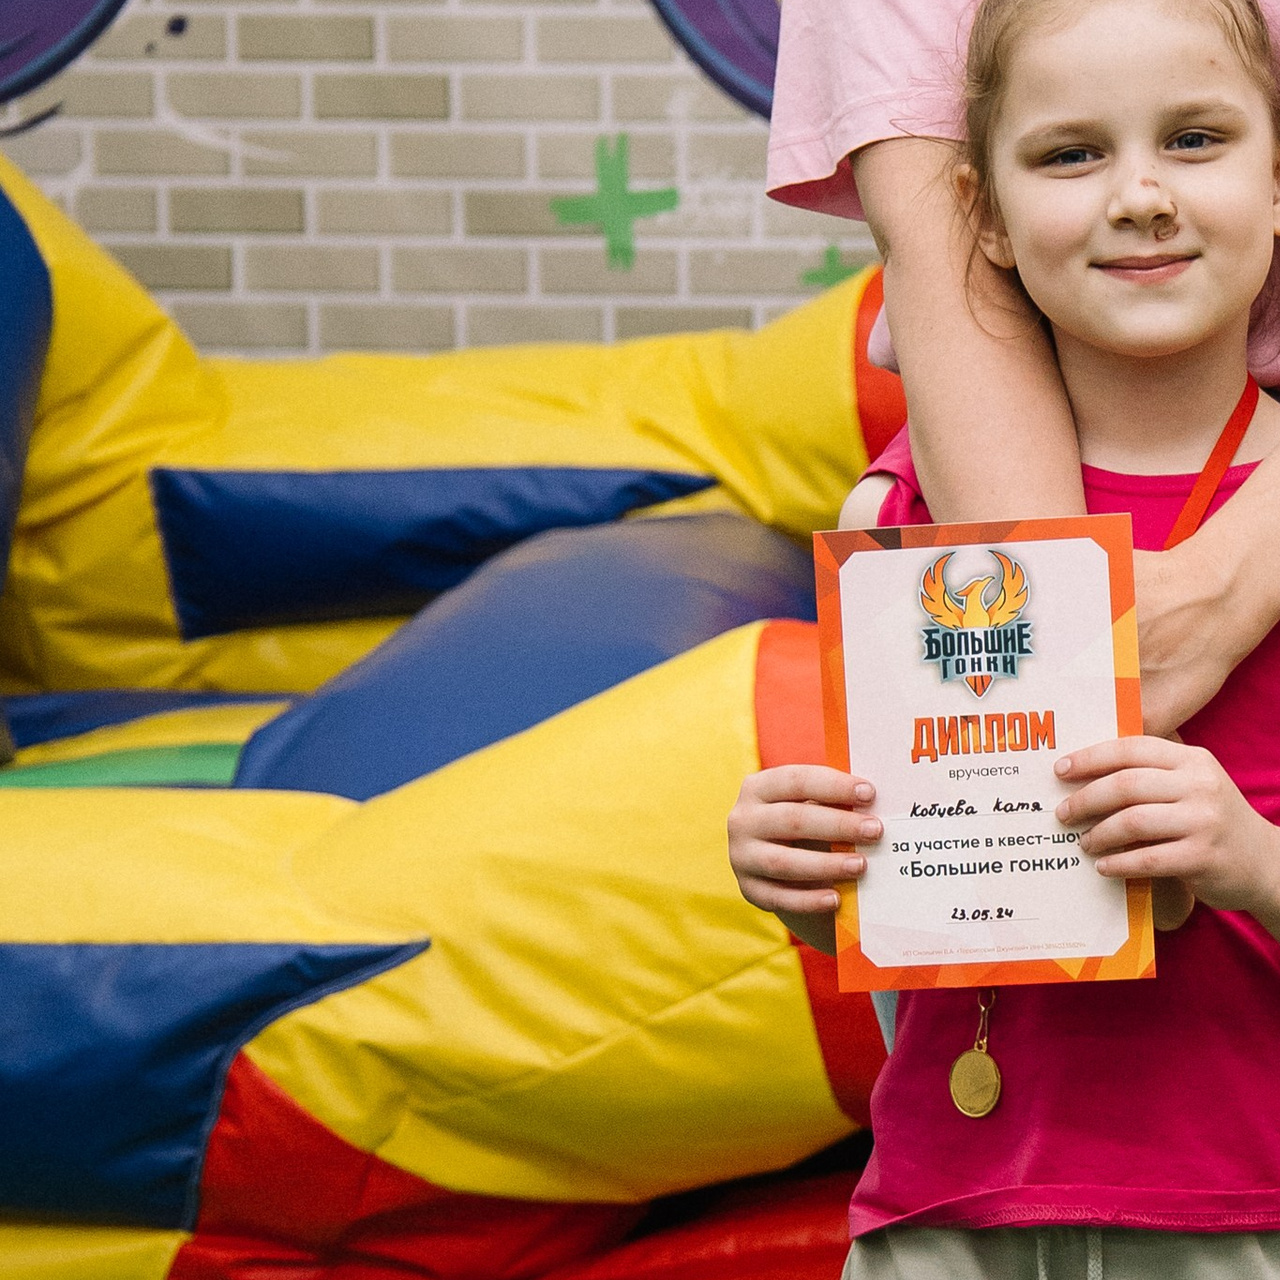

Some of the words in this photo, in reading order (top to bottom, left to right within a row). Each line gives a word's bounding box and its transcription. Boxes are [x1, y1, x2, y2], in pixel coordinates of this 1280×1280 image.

[922, 623, 1033, 660] БОЛЬШИЕ
[942, 655, 1016, 679] ГОНКИ
[911, 710, 1057, 764] ДИПЛОМ
[949, 765, 1019, 780] вручается
[892, 842, 910, 852] за
[914, 837, 980, 854] участие
[985, 837, 994, 847] в
[899, 859, 1004, 878] «Большие
[1009, 856, 1081, 873] гонки»
